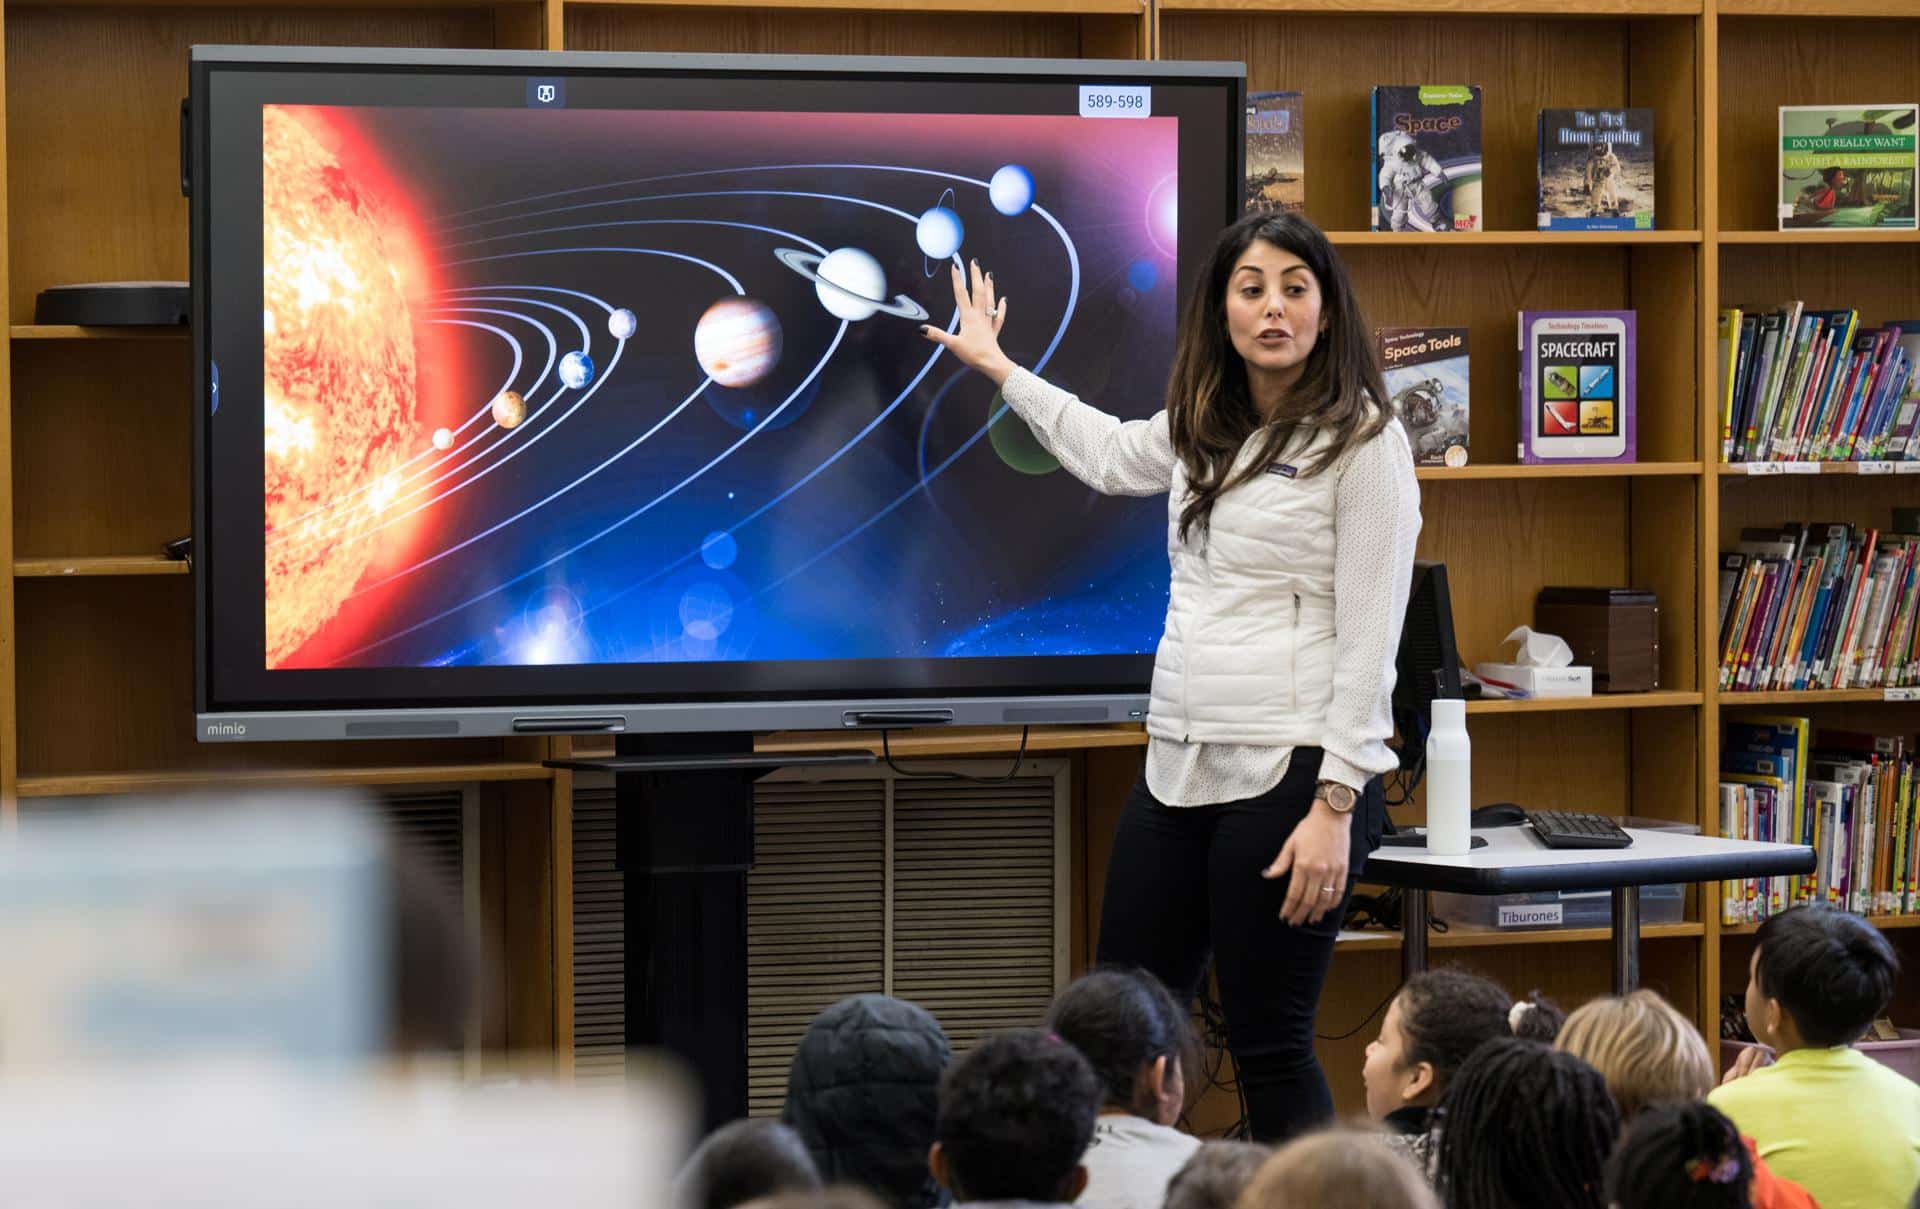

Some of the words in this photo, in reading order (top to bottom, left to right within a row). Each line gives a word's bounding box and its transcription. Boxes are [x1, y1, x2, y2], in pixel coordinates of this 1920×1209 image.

[1088, 94, 1143, 108] 589-598
[1394, 113, 1462, 135] Space
[1575, 111, 1595, 127] The
[1792, 139, 1807, 148] DO
[1809, 139, 1831, 148] YOU
[1833, 138, 1873, 148] REALLY
[1874, 137, 1906, 147] WANT
[1384, 343, 1427, 362] Space
[1427, 334, 1462, 352] Tools
[1541, 342, 1617, 358] SPACECRAFT
[207, 721, 246, 736] mimio
[1502, 910, 1560, 924] Tiburones
